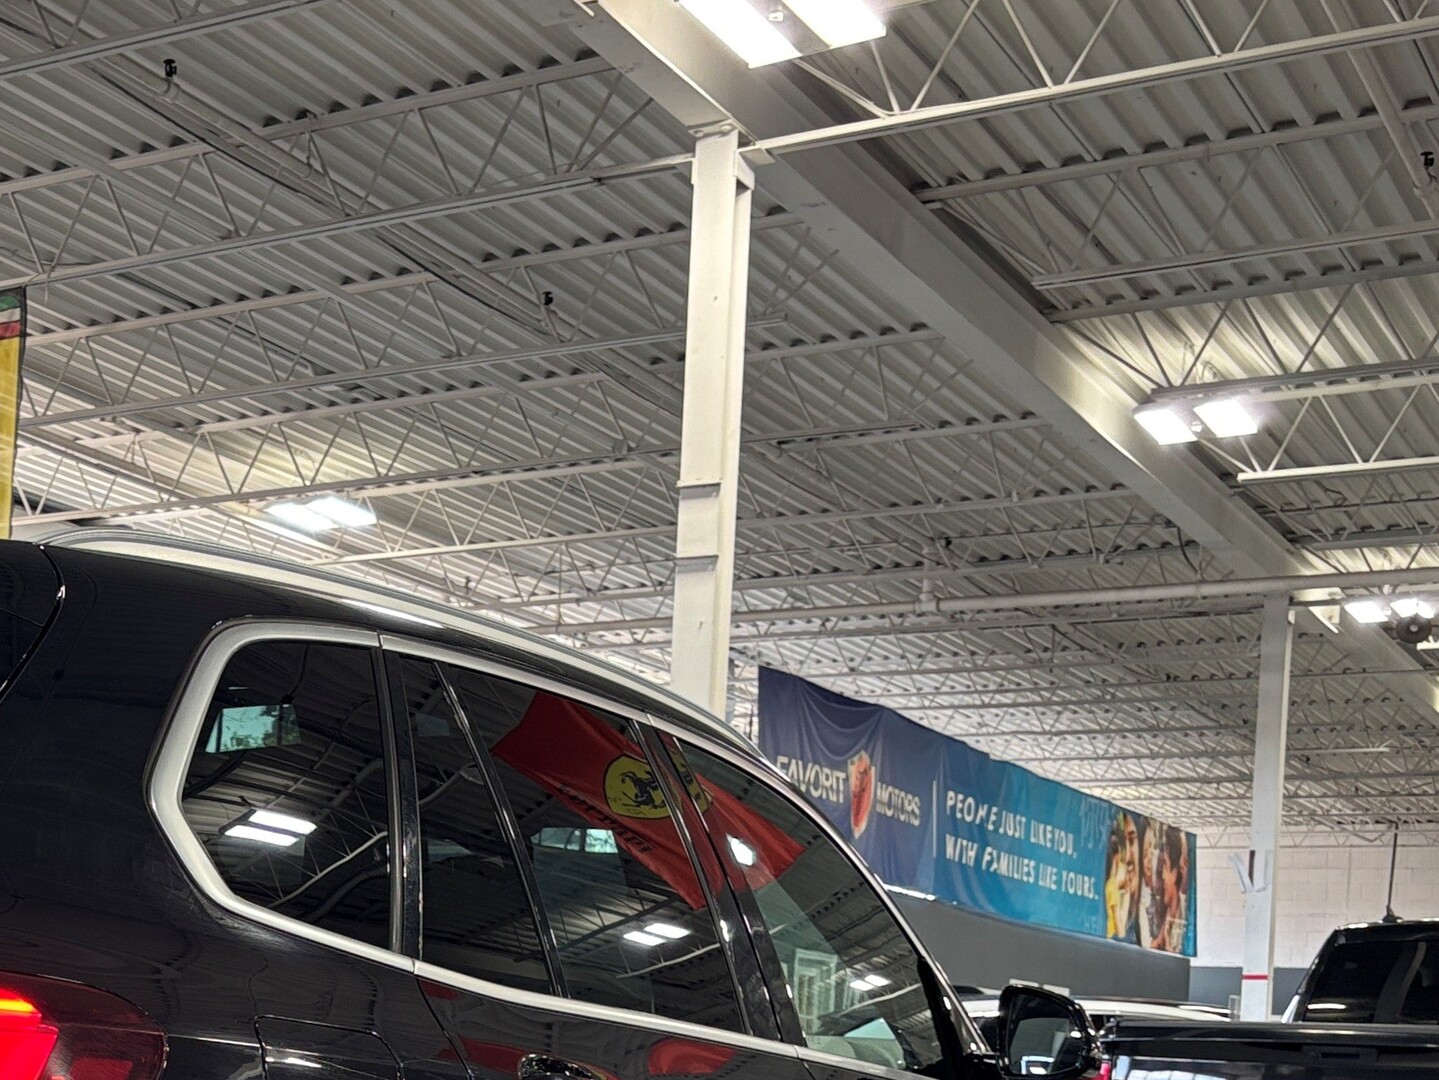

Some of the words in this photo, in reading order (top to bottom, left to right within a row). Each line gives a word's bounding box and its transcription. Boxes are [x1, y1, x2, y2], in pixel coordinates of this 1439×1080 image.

[876, 781, 921, 827] MOTORS
[998, 808, 1027, 841] JUST
[1030, 819, 1054, 849] LIKE
[945, 832, 980, 869] WITH
[981, 846, 1037, 885] FAMILIES
[1060, 869, 1100, 901] YOURS.
